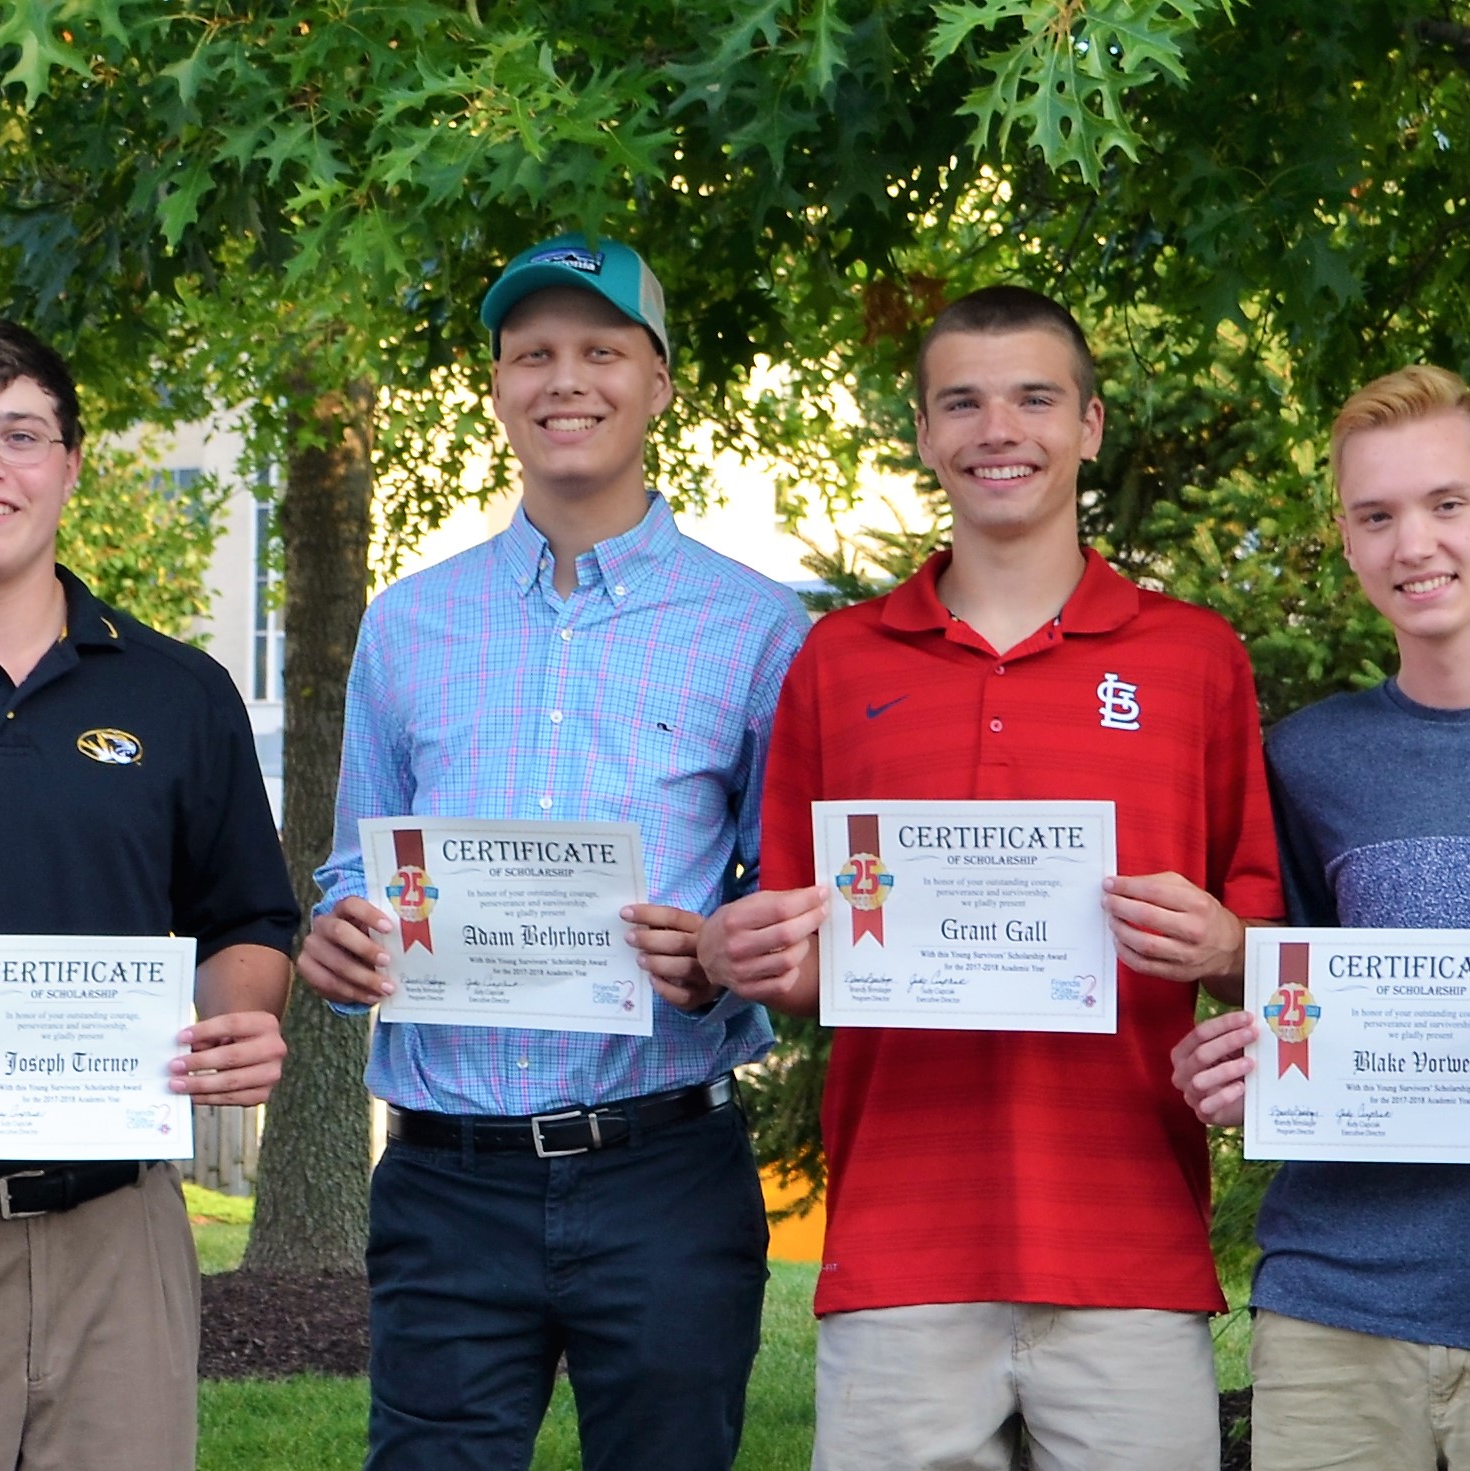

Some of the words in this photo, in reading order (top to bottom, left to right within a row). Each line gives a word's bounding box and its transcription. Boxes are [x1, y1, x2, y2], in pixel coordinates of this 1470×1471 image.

[899, 826, 1084, 849] CERTIFICATE
[442, 840, 615, 863] CERTIFICATE
[947, 856, 960, 864] OF
[964, 855, 1037, 865] SCHOLARSHIP
[490, 868, 502, 876] OF
[505, 868, 573, 878] SCHOLARSHIP
[851, 860, 880, 894] 25
[967, 880, 984, 888] your
[985, 878, 1028, 887] outstanding
[399, 872, 424, 906] 25
[936, 889, 984, 897] perseverance
[986, 888, 999, 896] and
[974, 899, 995, 908] gladly
[999, 900, 1025, 908] present
[940, 919, 998, 941] Grant
[1006, 921, 1048, 942] Gall
[462, 925, 514, 947] Adam
[521, 925, 611, 950] Behrhorst
[31, 990, 44, 998] OF
[47, 990, 118, 999] SCHOLARSHIP
[1377, 986, 1390, 994] OF
[1393, 986, 1467, 996] SCHOLARSHIP
[1278, 990, 1305, 1026] 25
[1361, 1008, 1382, 1016] honor
[1395, 1010, 1412, 1019] your
[1414, 1009, 1457, 1019] outstanding
[1364, 1020, 1412, 1028] perseverance
[1414, 1019, 1427, 1027] and
[1401, 1030, 1423, 1039] gladly
[1427, 1031, 1453, 1040] present
[4, 1051, 65, 1076] Joseph
[72, 1053, 139, 1076] Tierney
[1353, 1051, 1406, 1075] Blake
